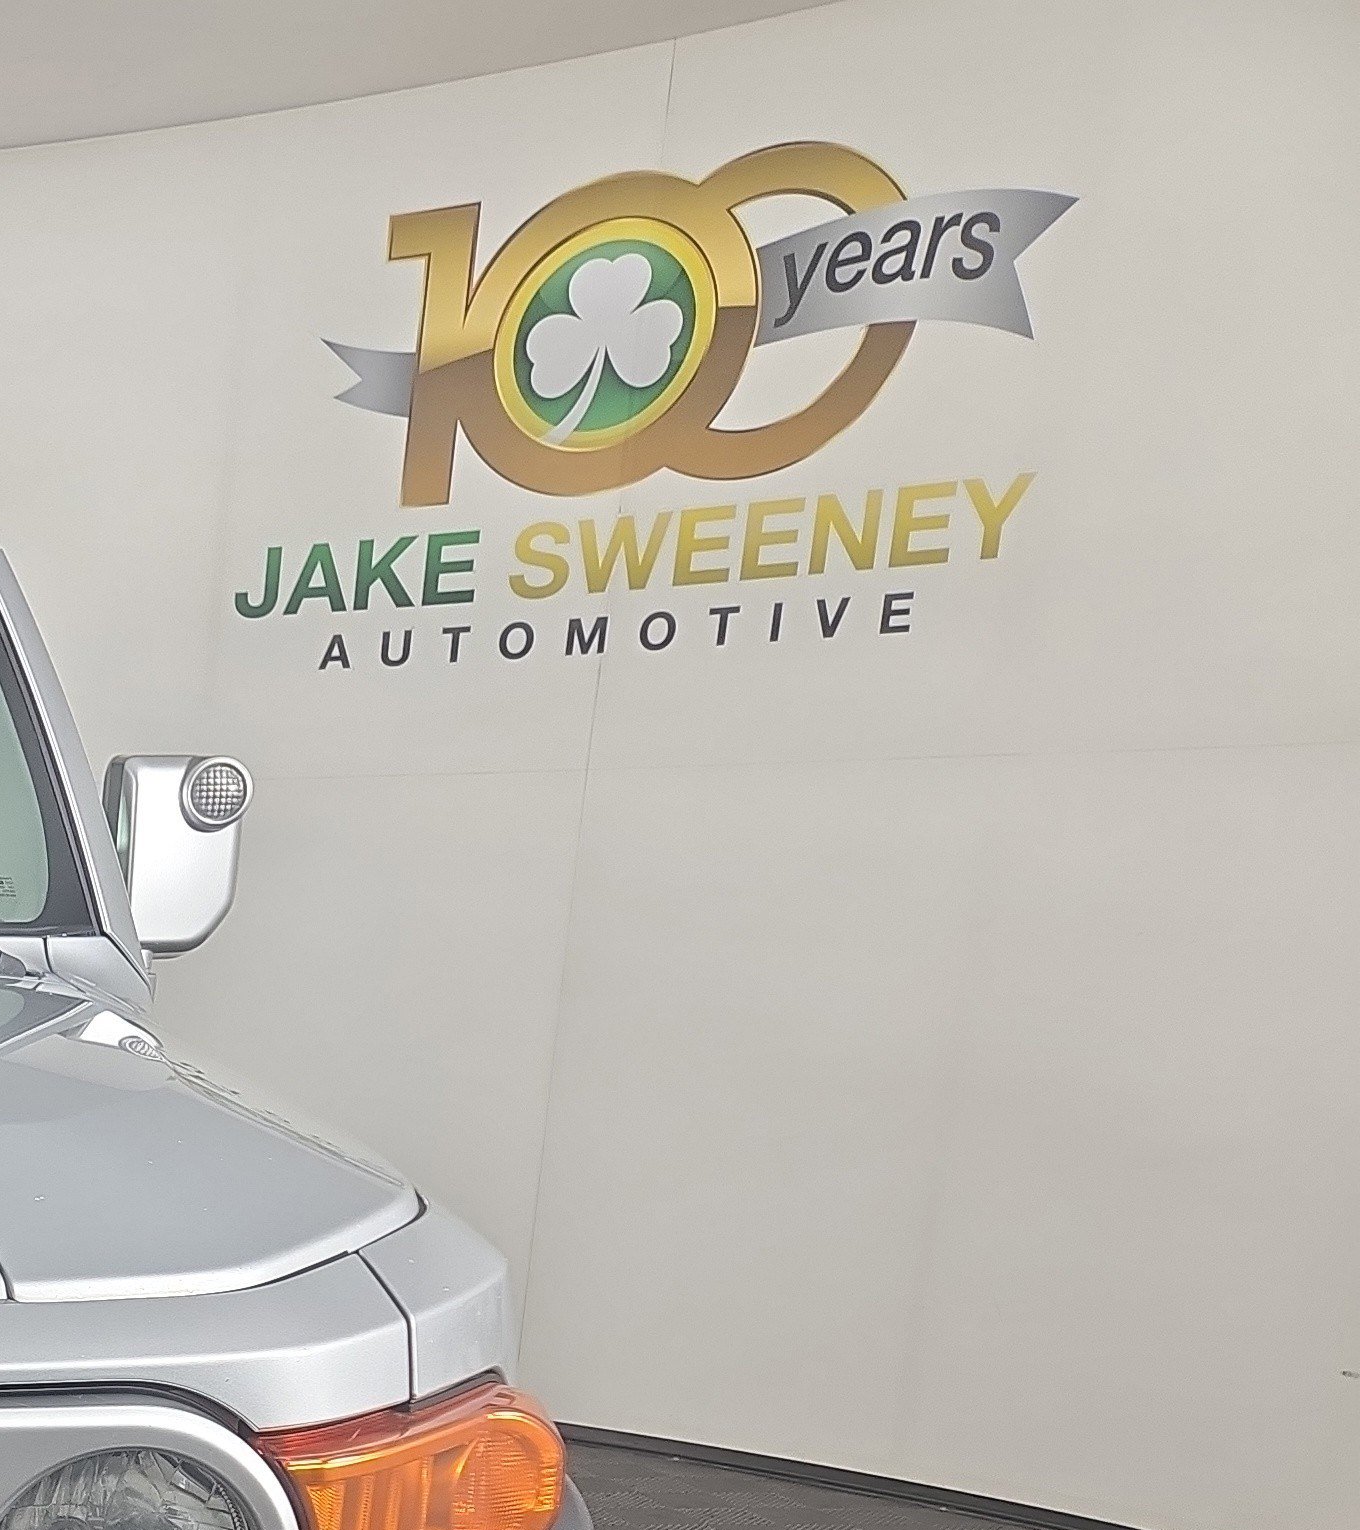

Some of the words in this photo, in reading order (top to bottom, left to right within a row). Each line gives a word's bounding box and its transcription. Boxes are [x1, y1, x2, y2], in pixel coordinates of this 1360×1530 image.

[387, 140, 918, 507] 100
[772, 208, 1002, 329] years
[234, 530, 481, 619] JAKE
[507, 471, 1038, 600] SWEENEY
[318, 592, 915, 671] AUTOMOTIVE
